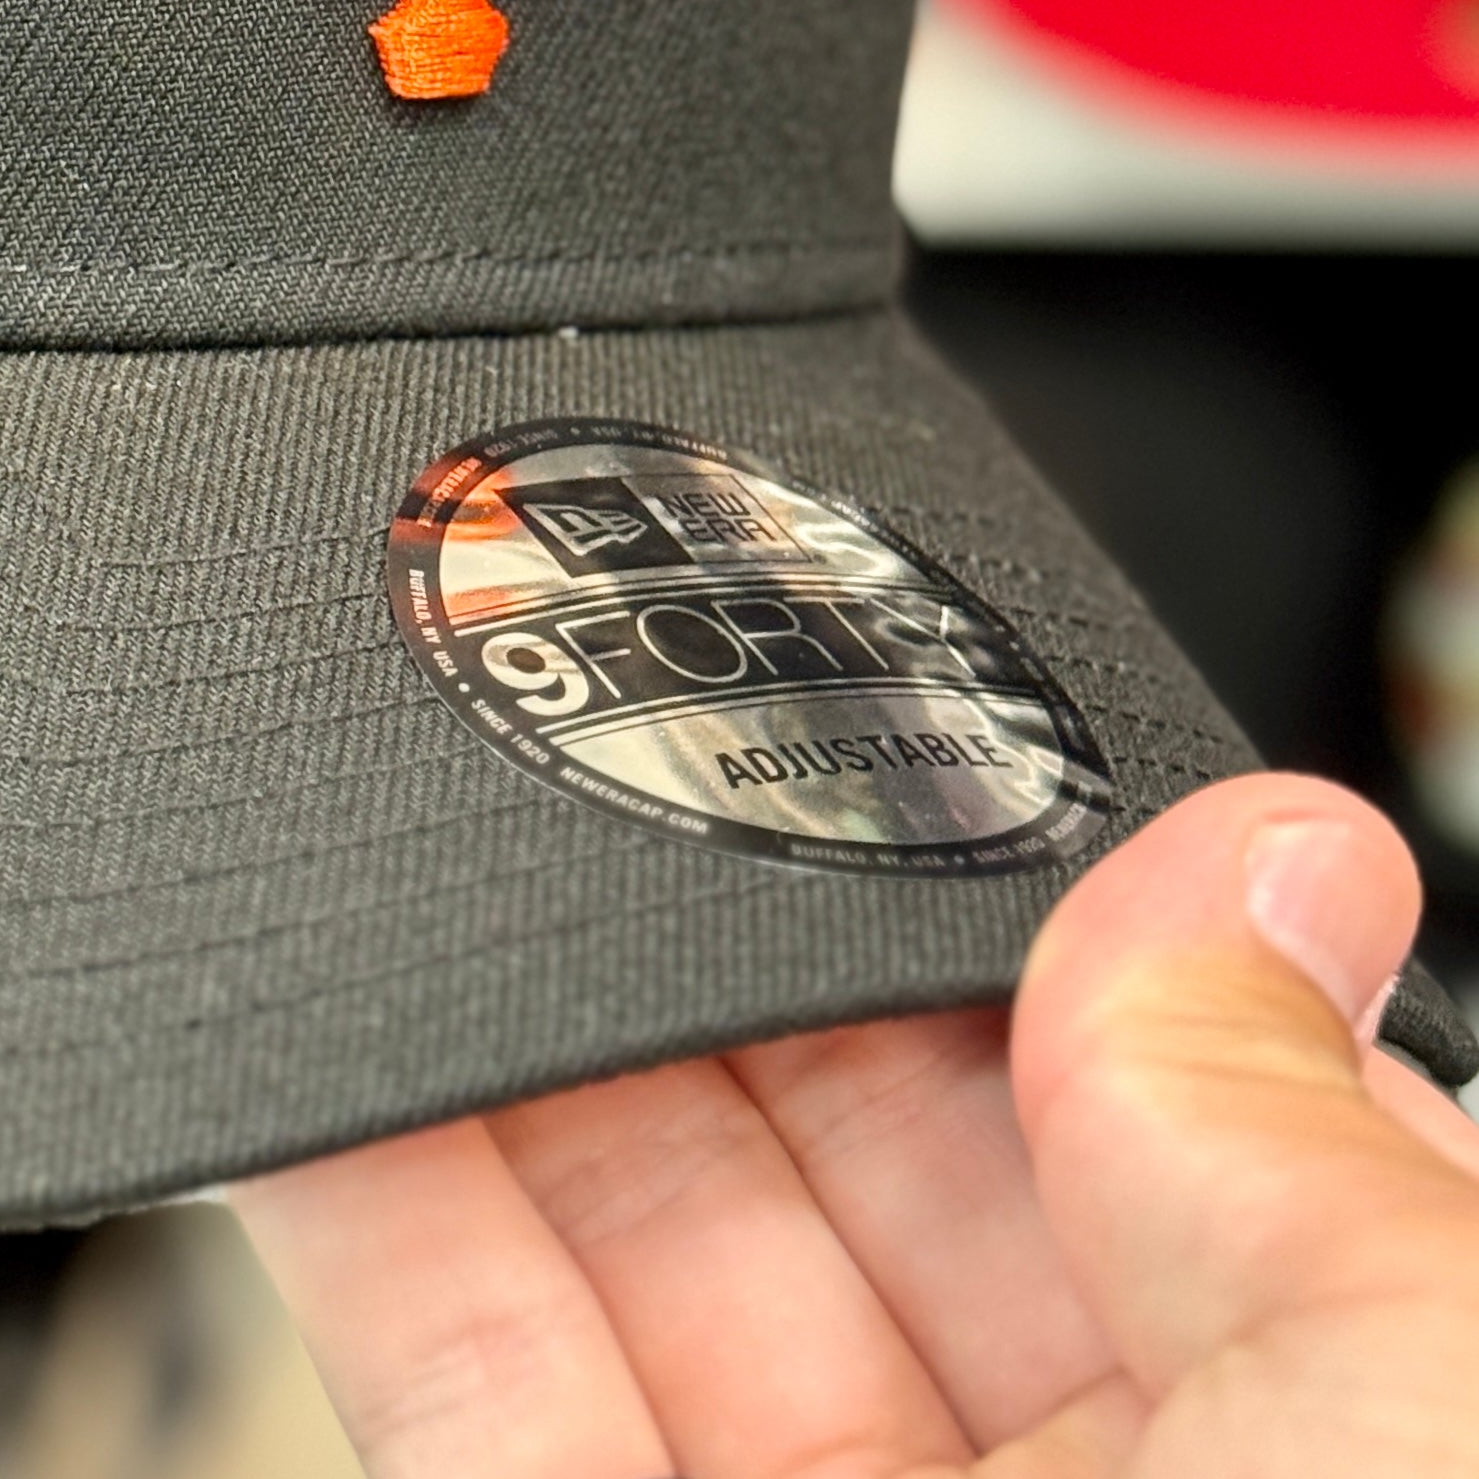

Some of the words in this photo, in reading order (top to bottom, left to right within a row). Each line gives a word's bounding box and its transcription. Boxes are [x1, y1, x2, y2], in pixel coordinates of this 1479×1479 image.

[654, 492, 751, 518] NEW
[678, 519, 777, 543] ERA
[481, 597, 977, 716] 9FORTY
[433, 650, 458, 677] USA
[471, 698, 513, 735] SINCE
[510, 733, 550, 765] 1920
[559, 766, 710, 835] NEWERACAP.COM
[714, 732, 1014, 789] ADJUSTABLE
